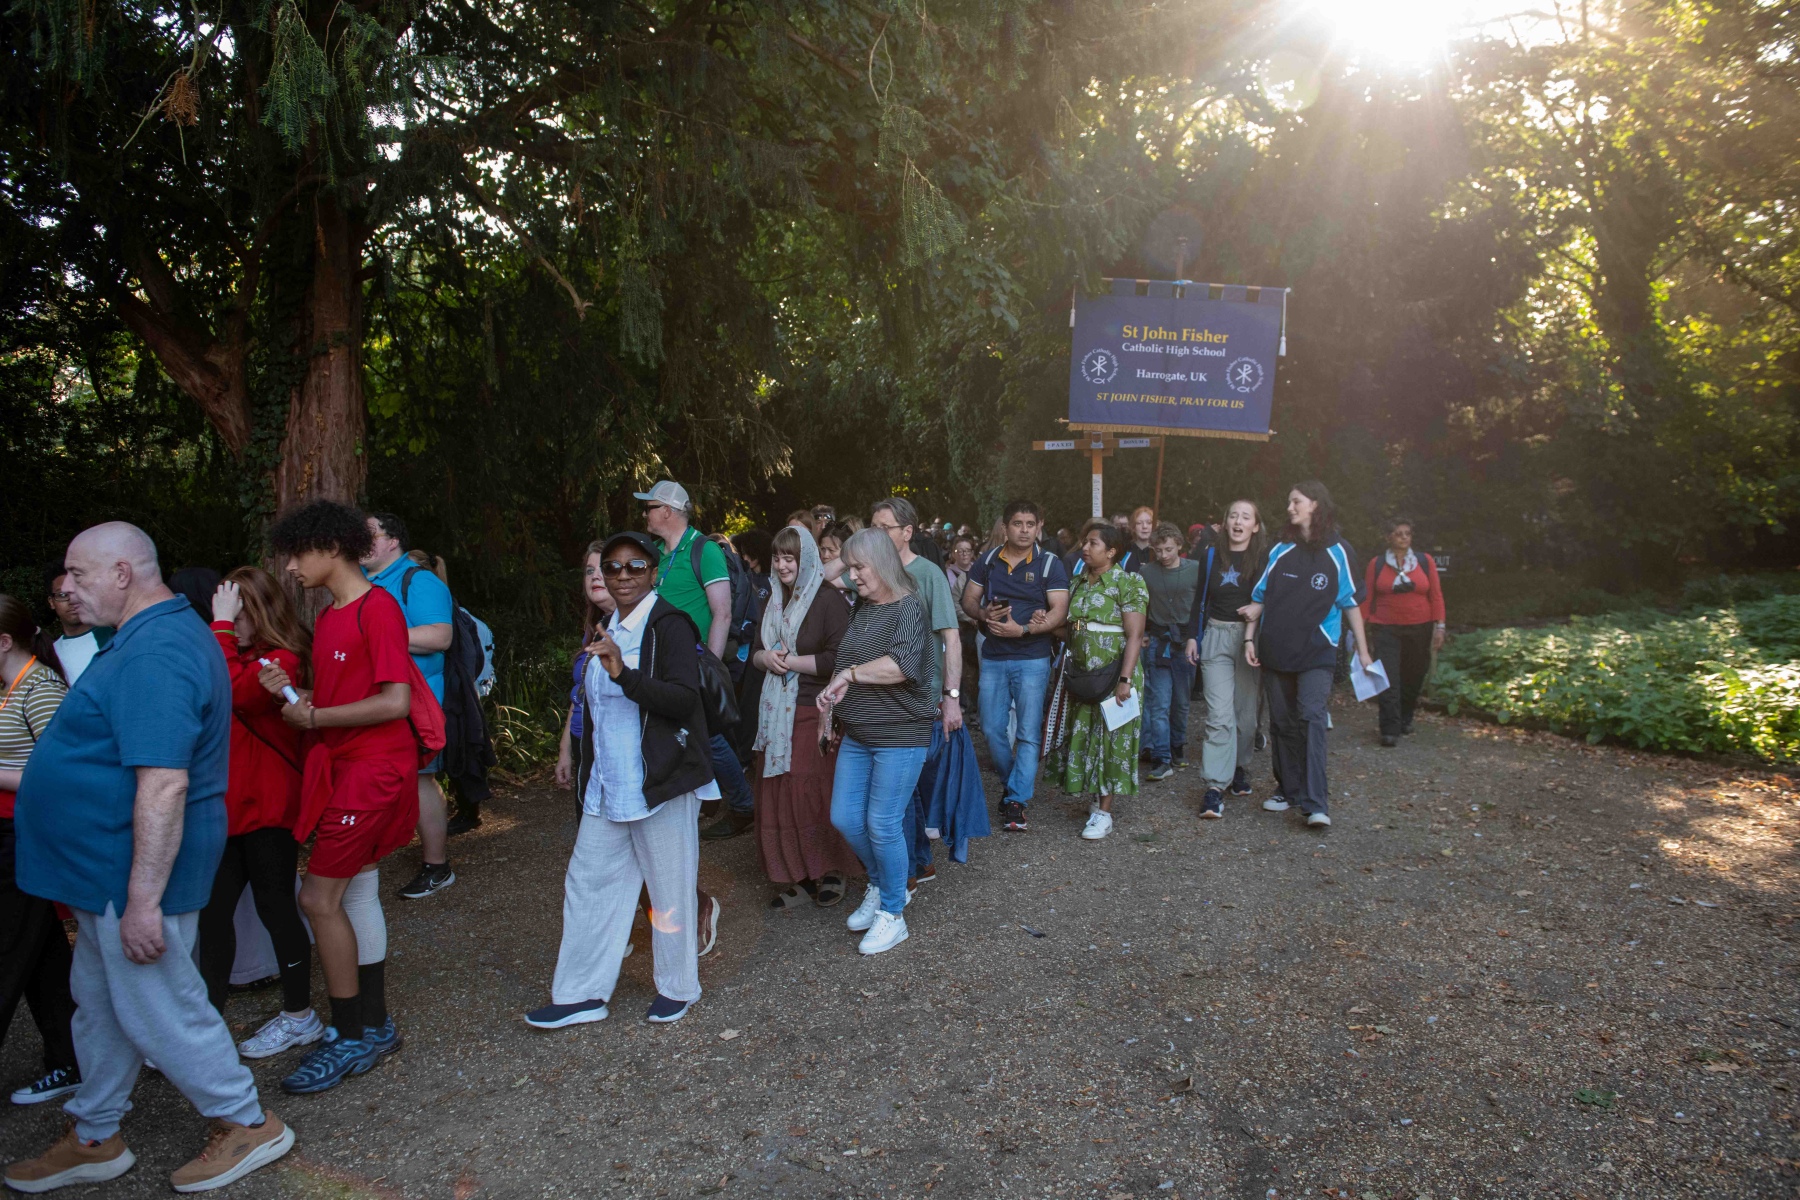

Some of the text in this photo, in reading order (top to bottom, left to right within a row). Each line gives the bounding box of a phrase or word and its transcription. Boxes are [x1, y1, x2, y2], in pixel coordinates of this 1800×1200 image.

[1122, 325, 1229, 344] St John Fisher
[1122, 342, 1226, 357] Catholic High School
[1136, 369, 1208, 382] Harrogate, UK
[1096, 392, 1245, 409] ST JOHN FISHER, PRAY FOR US
